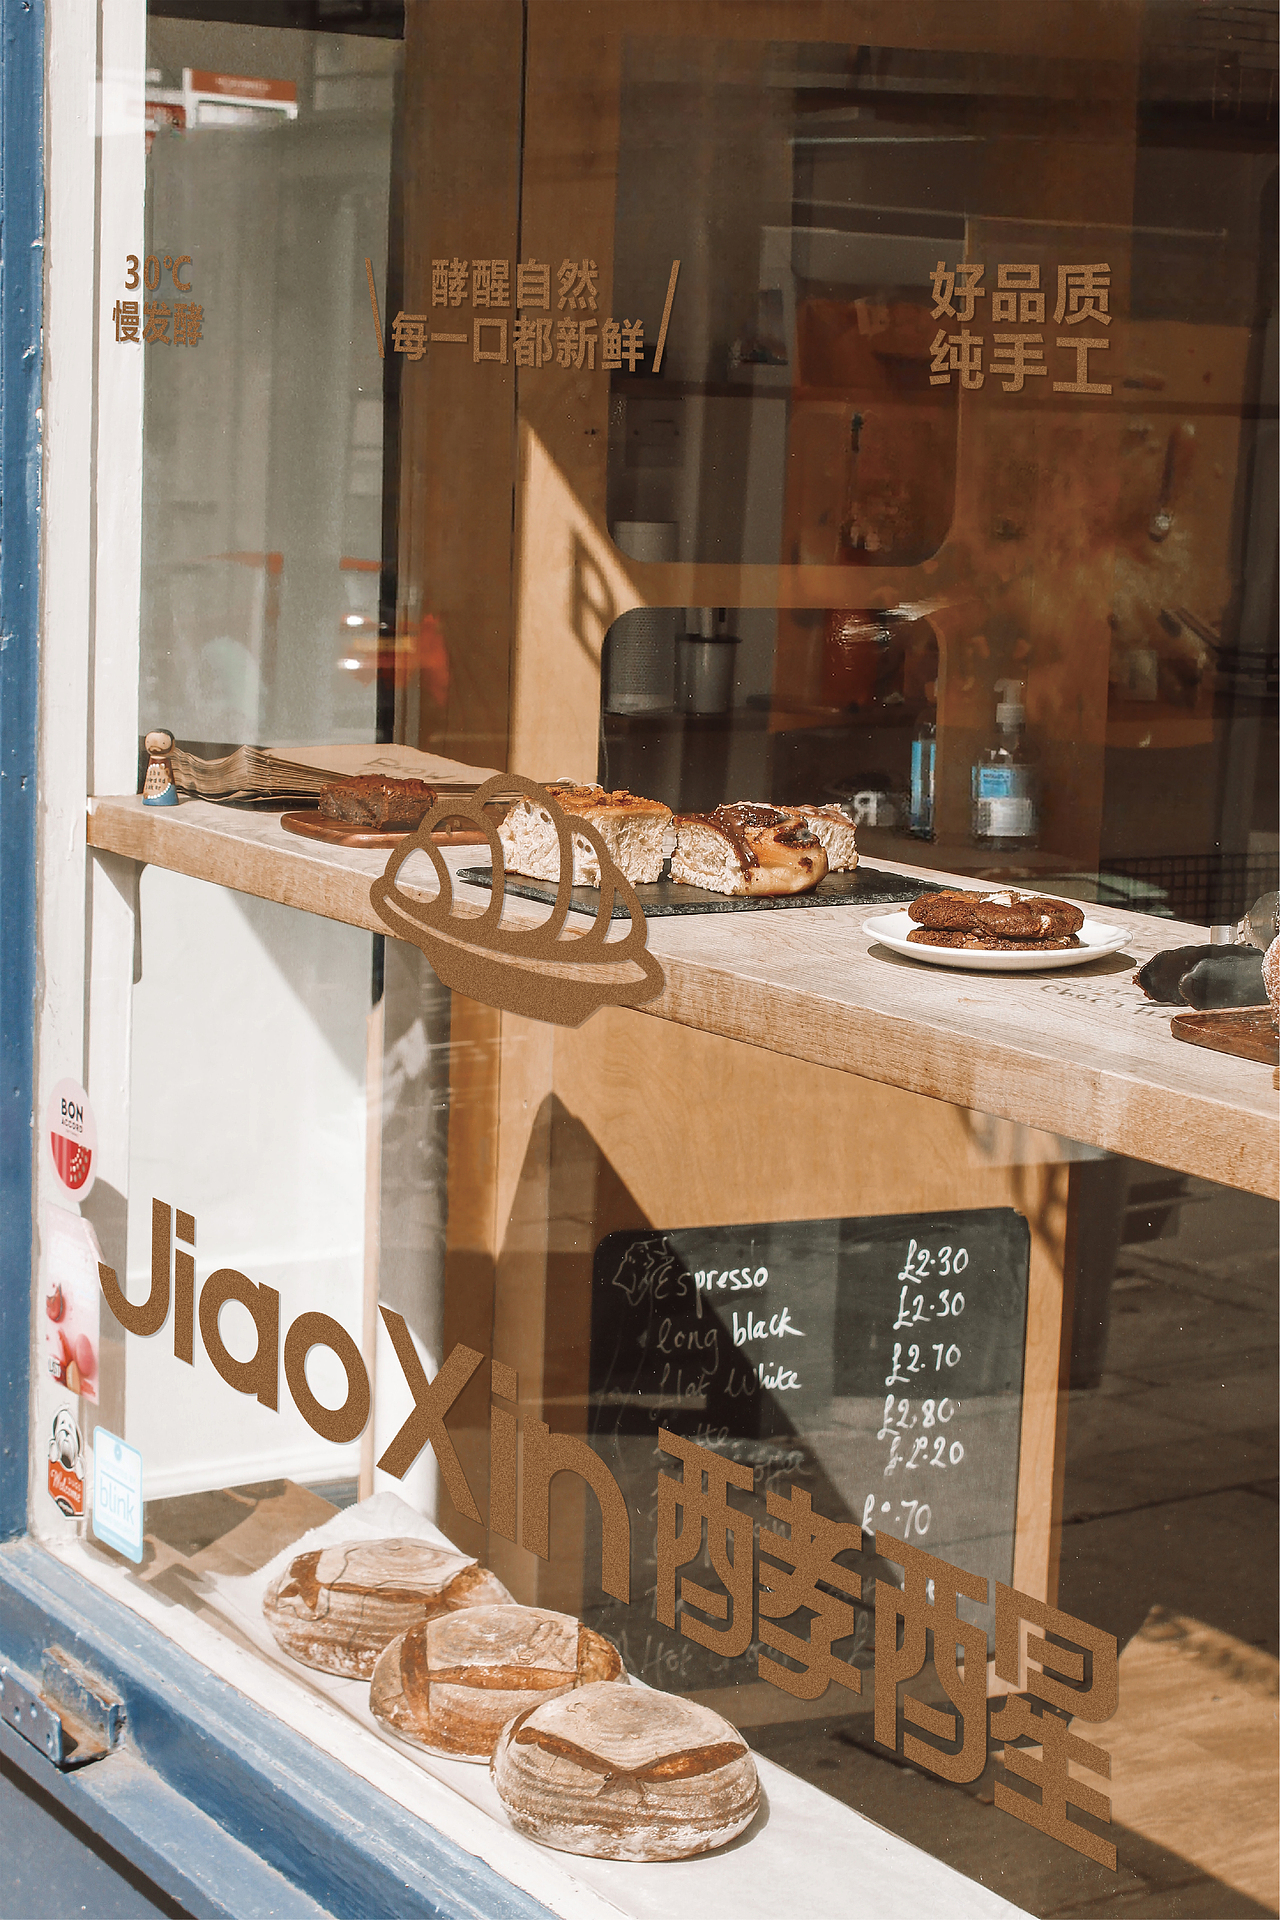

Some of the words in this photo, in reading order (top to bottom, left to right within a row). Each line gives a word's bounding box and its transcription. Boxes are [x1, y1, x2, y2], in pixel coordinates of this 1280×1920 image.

[431, 257, 599, 311] 酵醒自然
[929, 261, 1113, 326] 好品质
[112, 300, 203, 346] 慢发酵
[391, 311, 645, 372] 每一口都新鲜
[929, 328, 1113, 395] 纯手工
[61, 1097, 83, 1124] BON
[61, 1118, 83, 1133] ACCORD
[653, 1264, 769, 1318] Espresso
[731, 1307, 808, 1347] black
[100, 1476, 135, 1525] blink
[656, 1426, 1119, 1873] 酵醒
